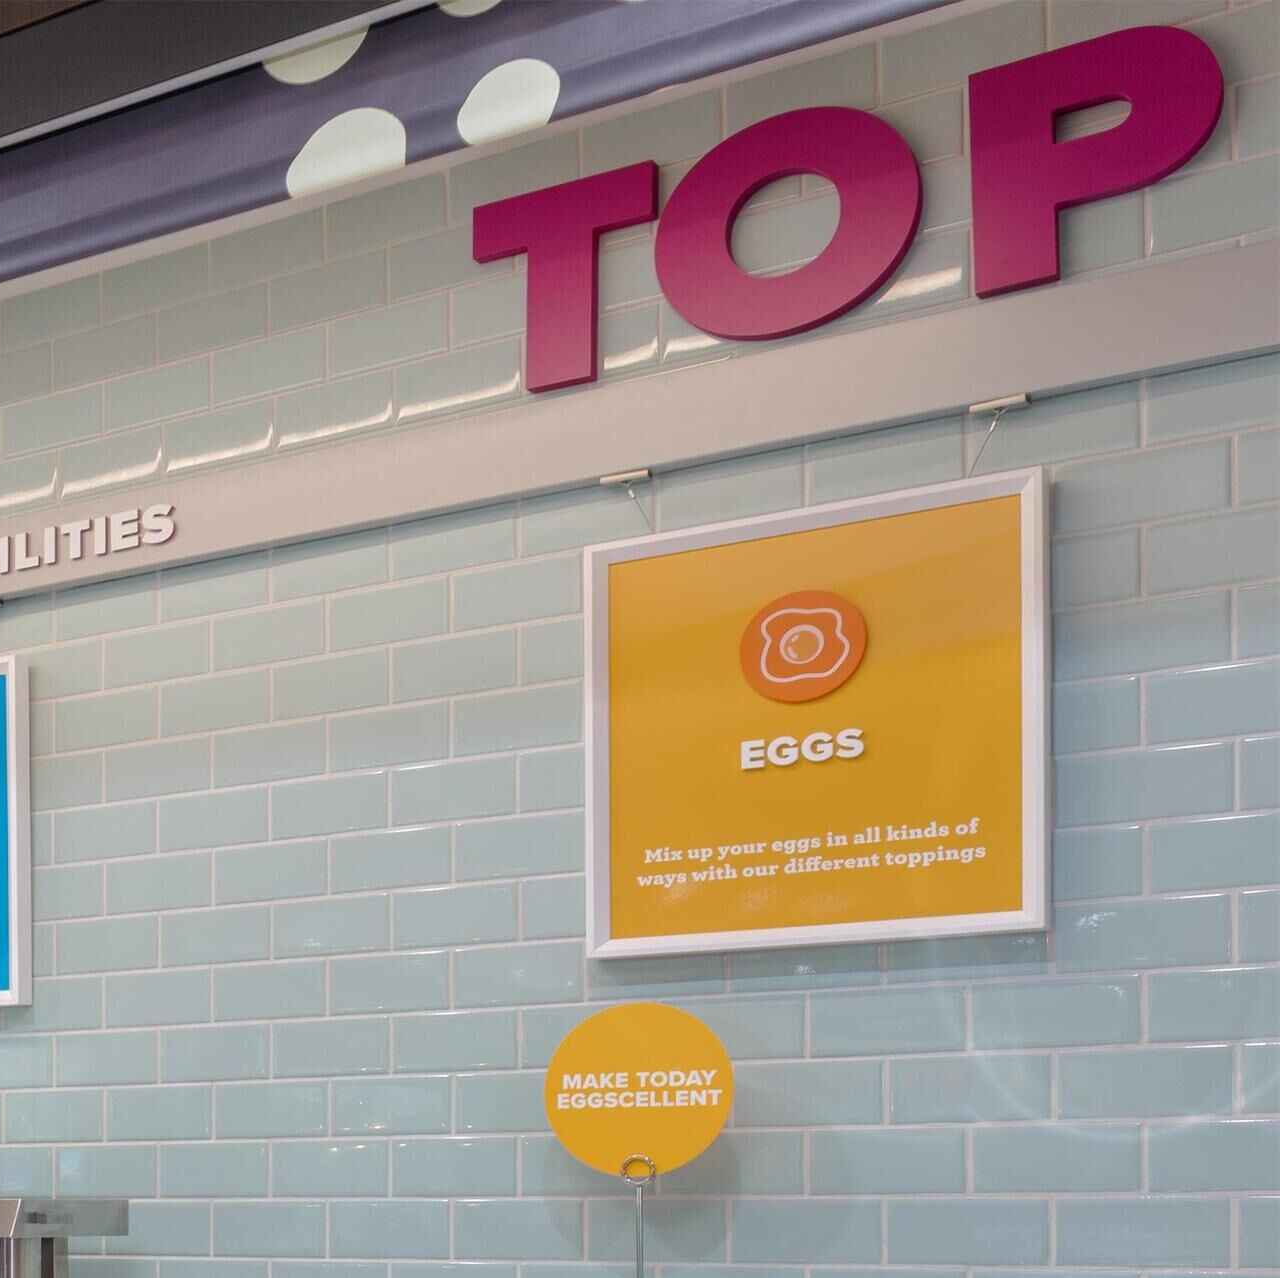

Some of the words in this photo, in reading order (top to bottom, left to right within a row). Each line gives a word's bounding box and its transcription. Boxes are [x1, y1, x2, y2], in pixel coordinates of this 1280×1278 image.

[473, 25, 1225, 393] TOP
[741, 728, 865, 770] EGGS
[644, 847, 683, 863] Mix
[687, 847, 713, 862] up
[717, 842, 767, 860] your
[771, 836, 821, 854] eggs
[826, 831, 848, 847] in
[854, 826, 881, 845] all
[886, 821, 949, 841] kinds
[955, 817, 980, 835] of
[637, 871, 687, 888] ways
[691, 864, 737, 881] with
[742, 864, 779, 877] our
[784, 853, 880, 874] different
[884, 846, 986, 868] toppings
[557, 1089, 723, 1109] EGGSCELLENT
[562, 1072, 629, 1089] MAKE
[635, 1069, 717, 1088] TODAY
